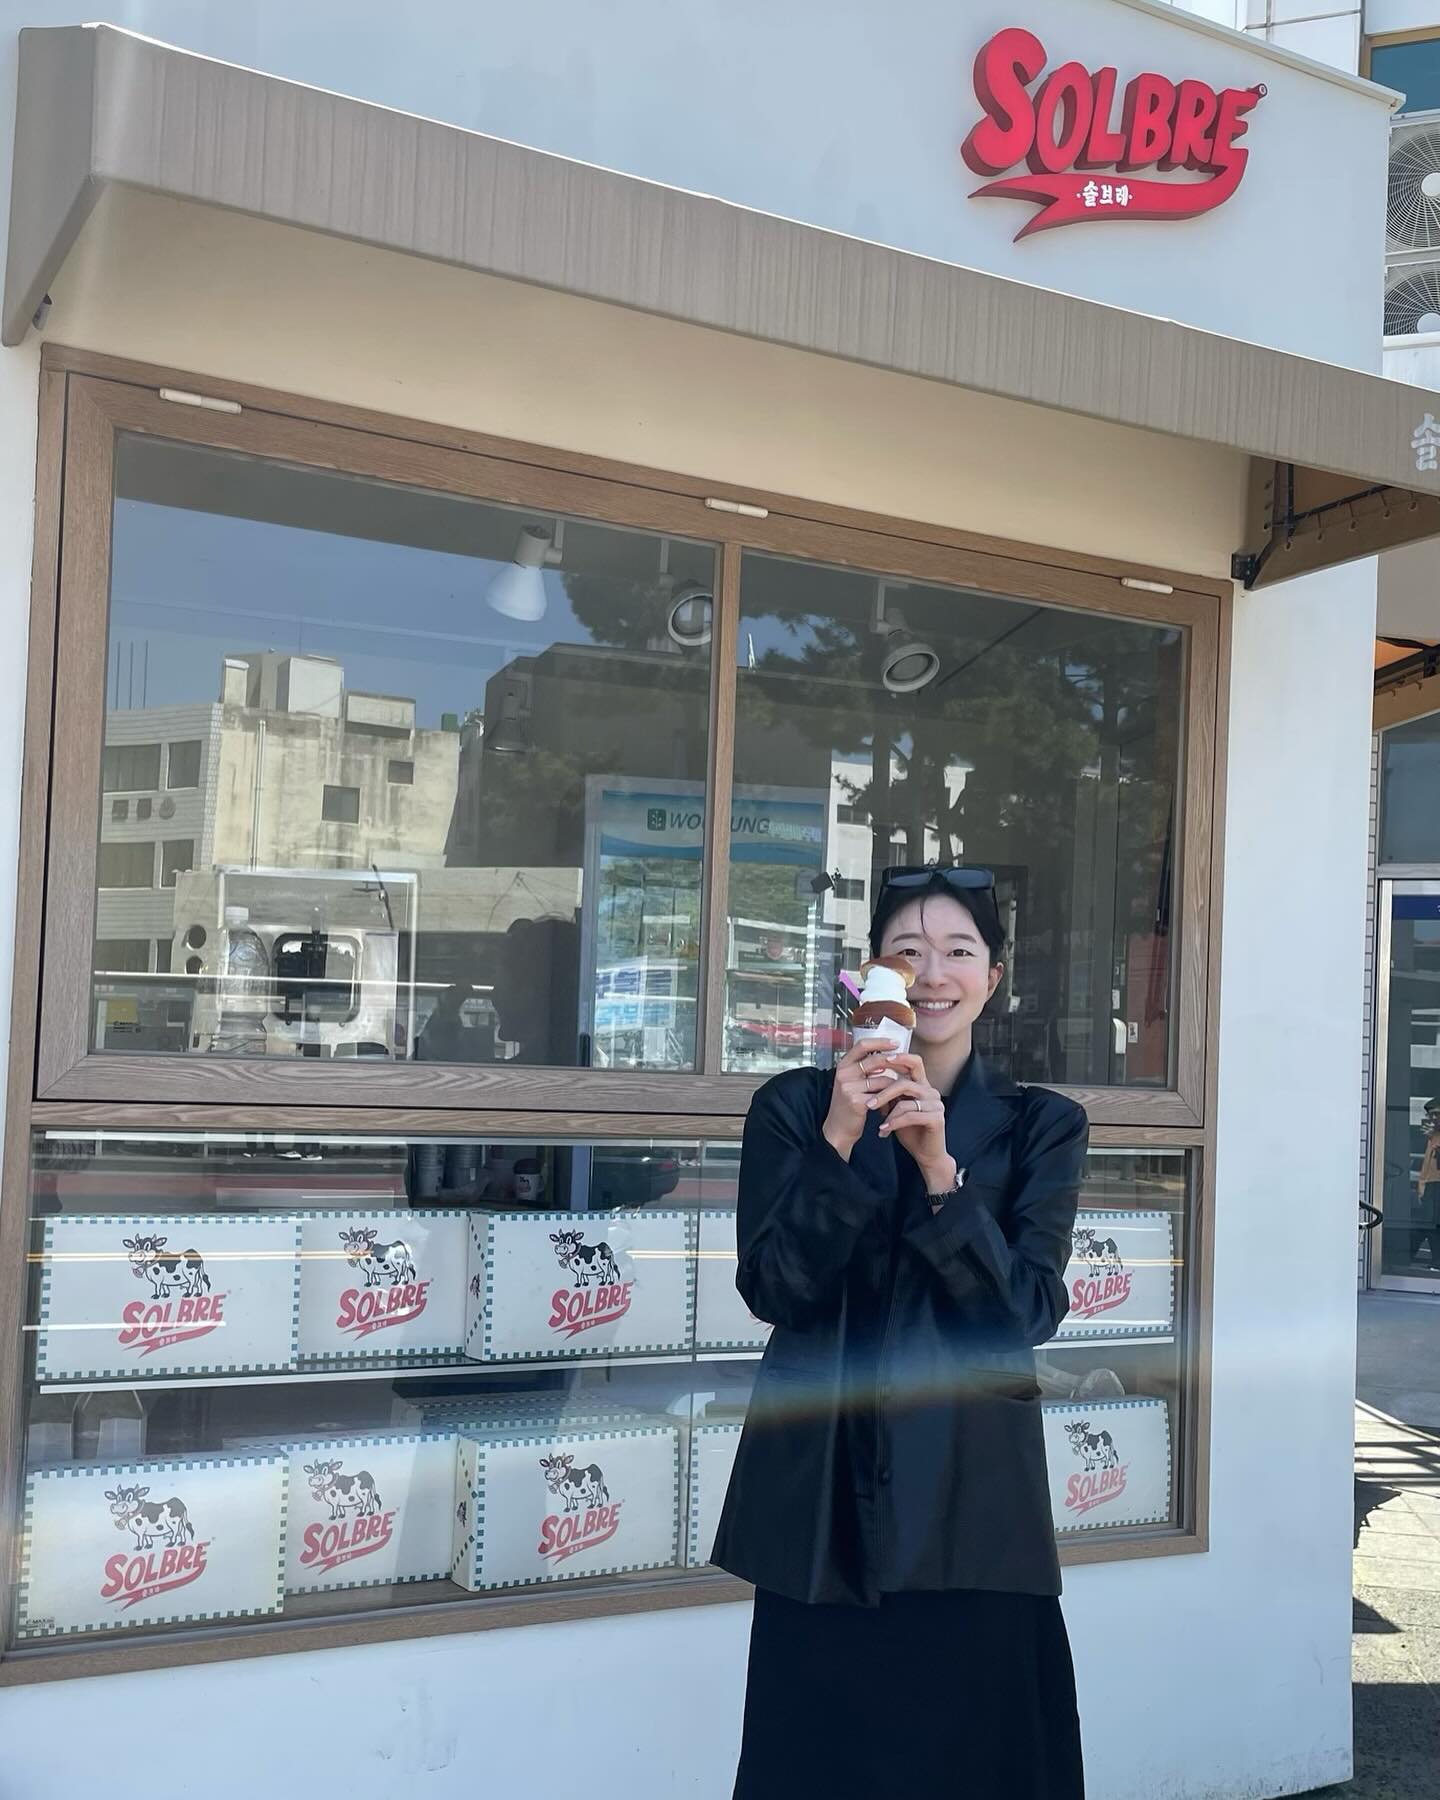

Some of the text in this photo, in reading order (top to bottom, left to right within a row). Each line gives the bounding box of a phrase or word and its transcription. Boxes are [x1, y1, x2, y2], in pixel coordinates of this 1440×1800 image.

[961, 28, 1259, 177] SOLBRE
[670, 812, 770, 834] WOUNG
[337, 1281, 431, 1328] SOLBRE
[548, 1281, 634, 1328] SOLBRE
[1071, 1272, 1133, 1312] SOLBRE
[118, 1294, 227, 1344] SOLBRE
[1064, 1465, 1129, 1508] SOLBRE
[300, 1511, 396, 1564] SOLBRE
[538, 1503, 622, 1554] SOLBRE
[100, 1541, 211, 1598] SOLBRE
